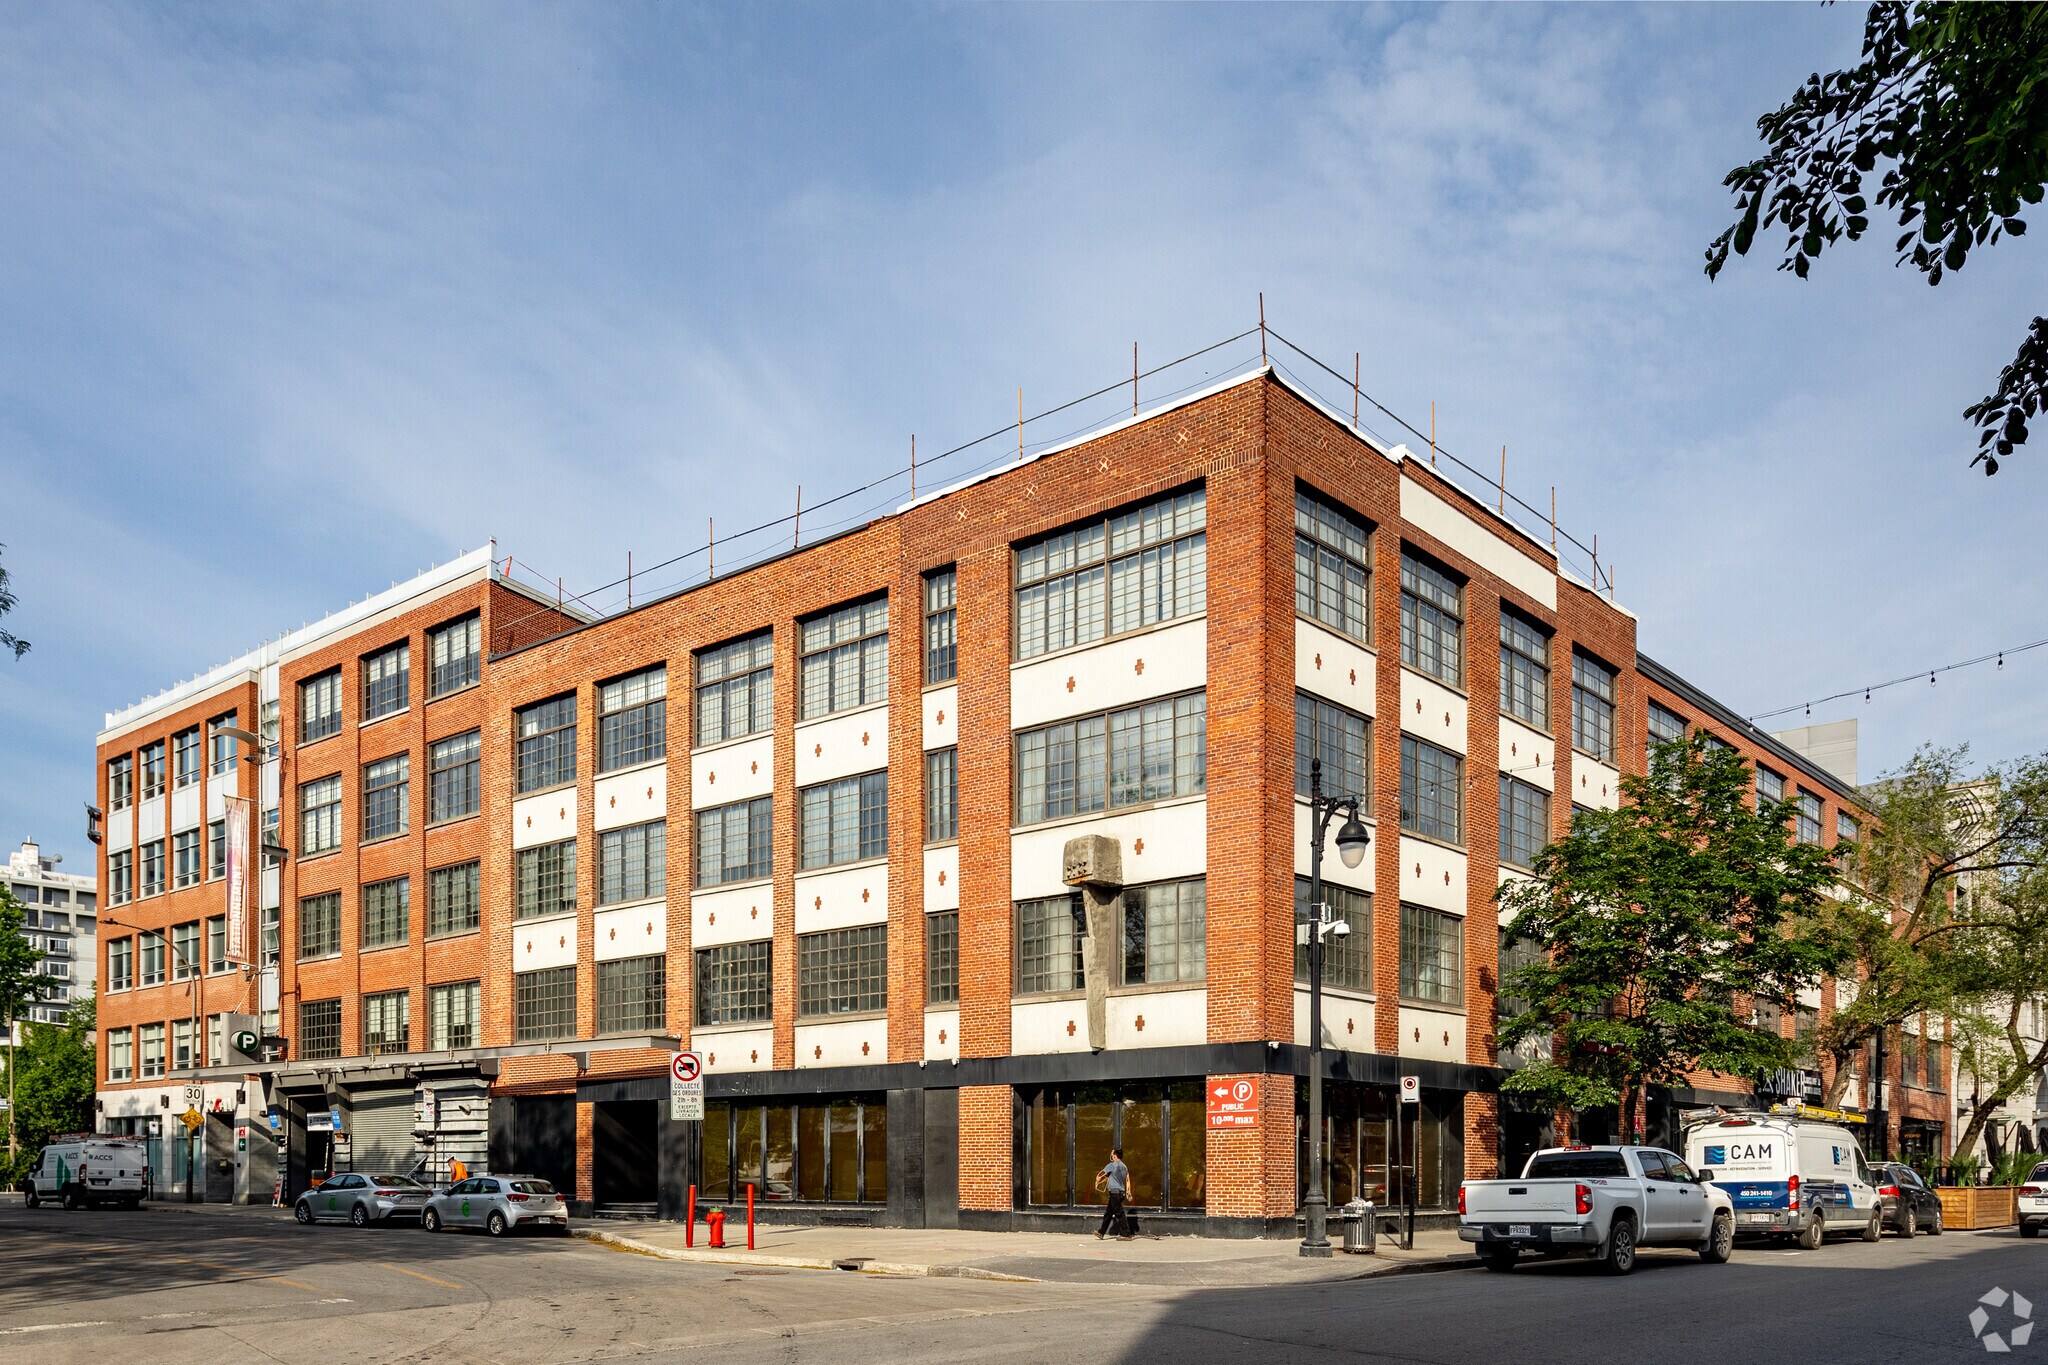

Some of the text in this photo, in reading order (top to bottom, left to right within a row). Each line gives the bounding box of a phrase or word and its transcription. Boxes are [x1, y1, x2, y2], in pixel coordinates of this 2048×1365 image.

[231, 864, 242, 957] STATIONNEMENT
[242, 1034, 256, 1049] P
[1775, 1068, 1806, 1098] SHAKER
[186, 1088, 201, 1100] 30
[1238, 1084, 1249, 1099] P
[1221, 1103, 1245, 1111] PUBLIC
[1235, 1116, 1255, 1125] max
[1730, 1144, 1772, 1160] CAM
